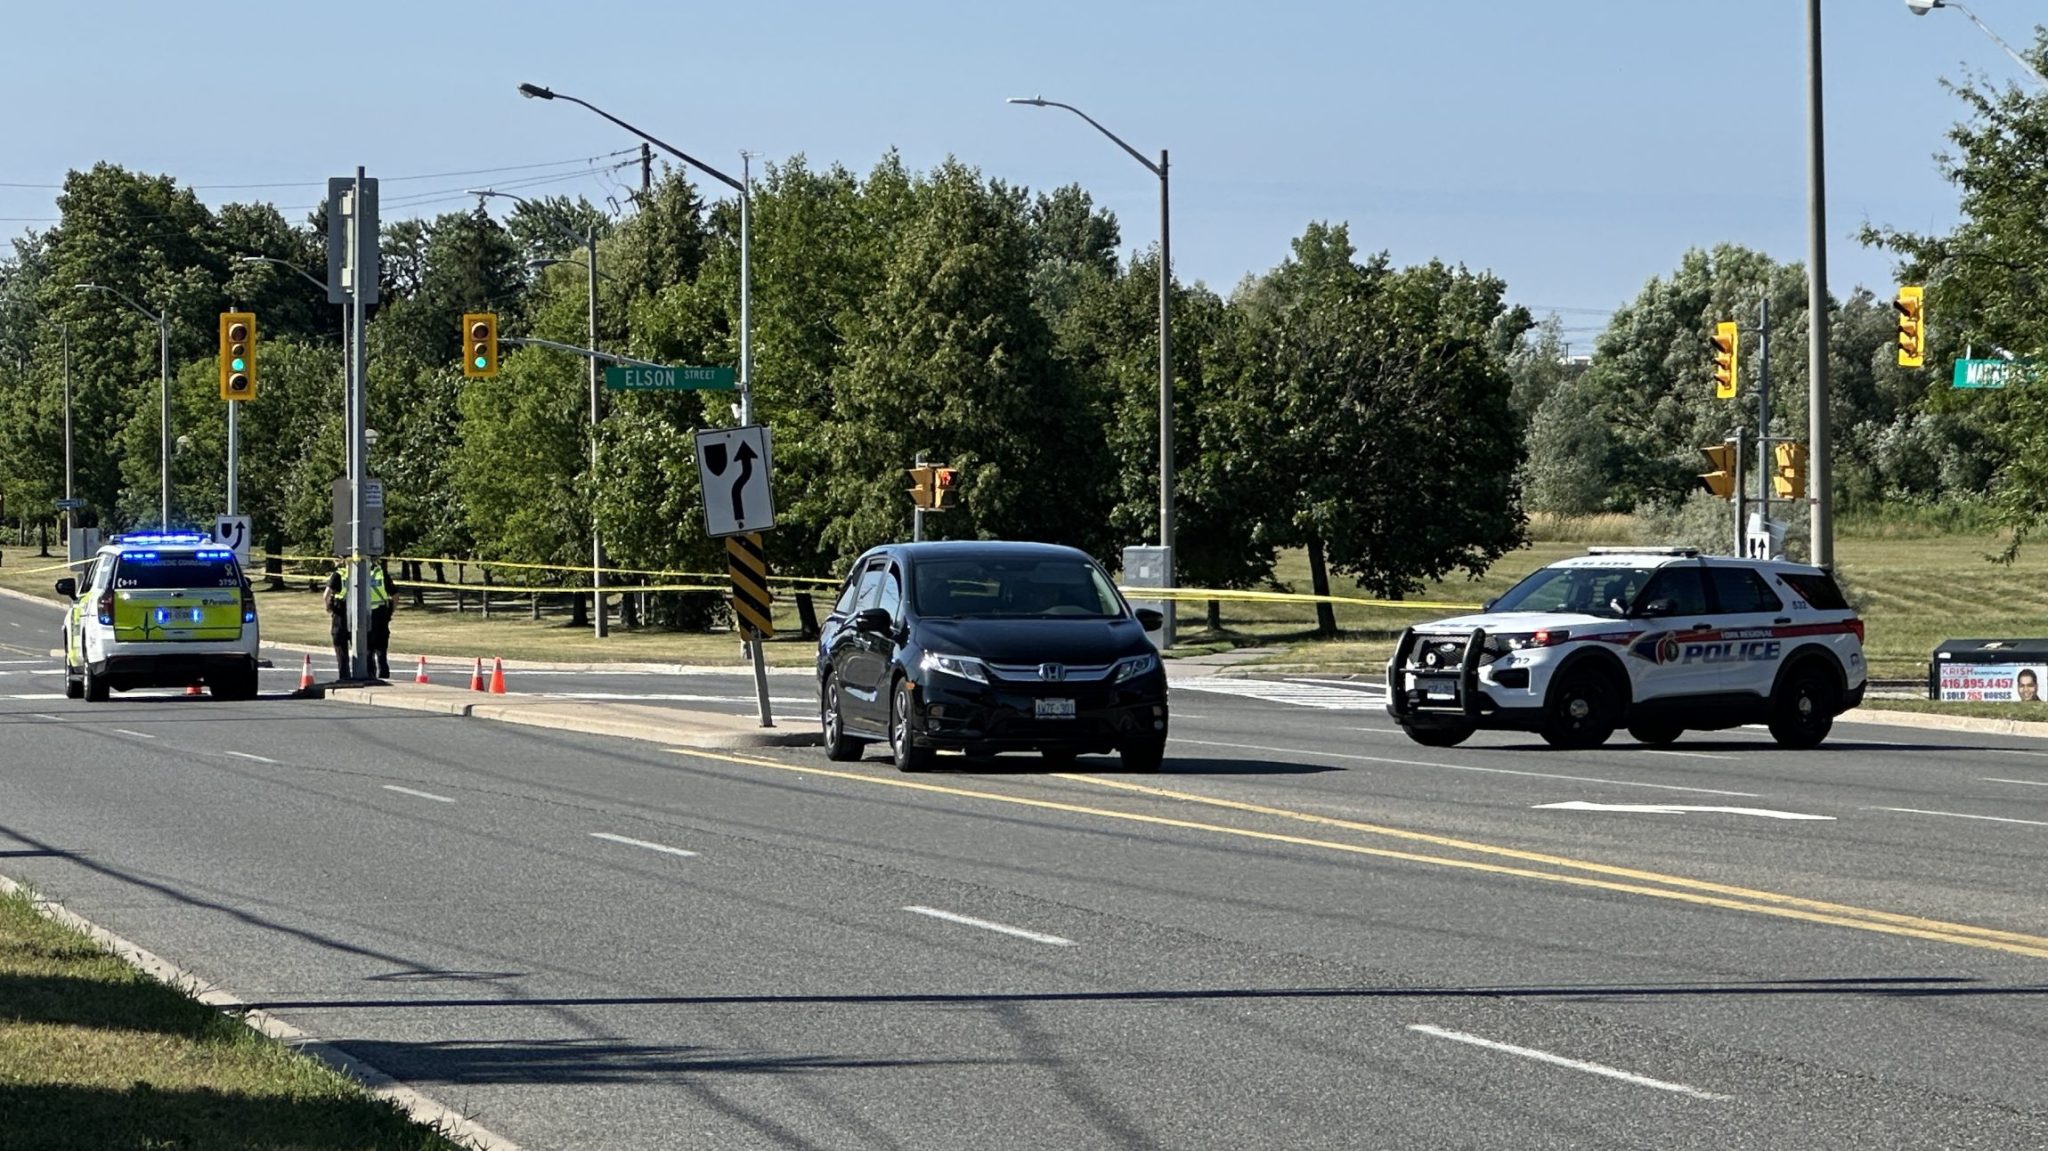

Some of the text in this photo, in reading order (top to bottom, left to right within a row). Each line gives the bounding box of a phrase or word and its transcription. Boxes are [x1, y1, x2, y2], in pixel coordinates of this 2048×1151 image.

[625, 370, 715, 387] ELSON STREET
[1681, 641, 1781, 664] POLICE
[1942, 667, 1974, 676] KRISH
[1941, 678, 2014, 689] 416.895.4457
[1946, 691, 1966, 700] SOLD
[1984, 691, 2012, 699] HOUSES
